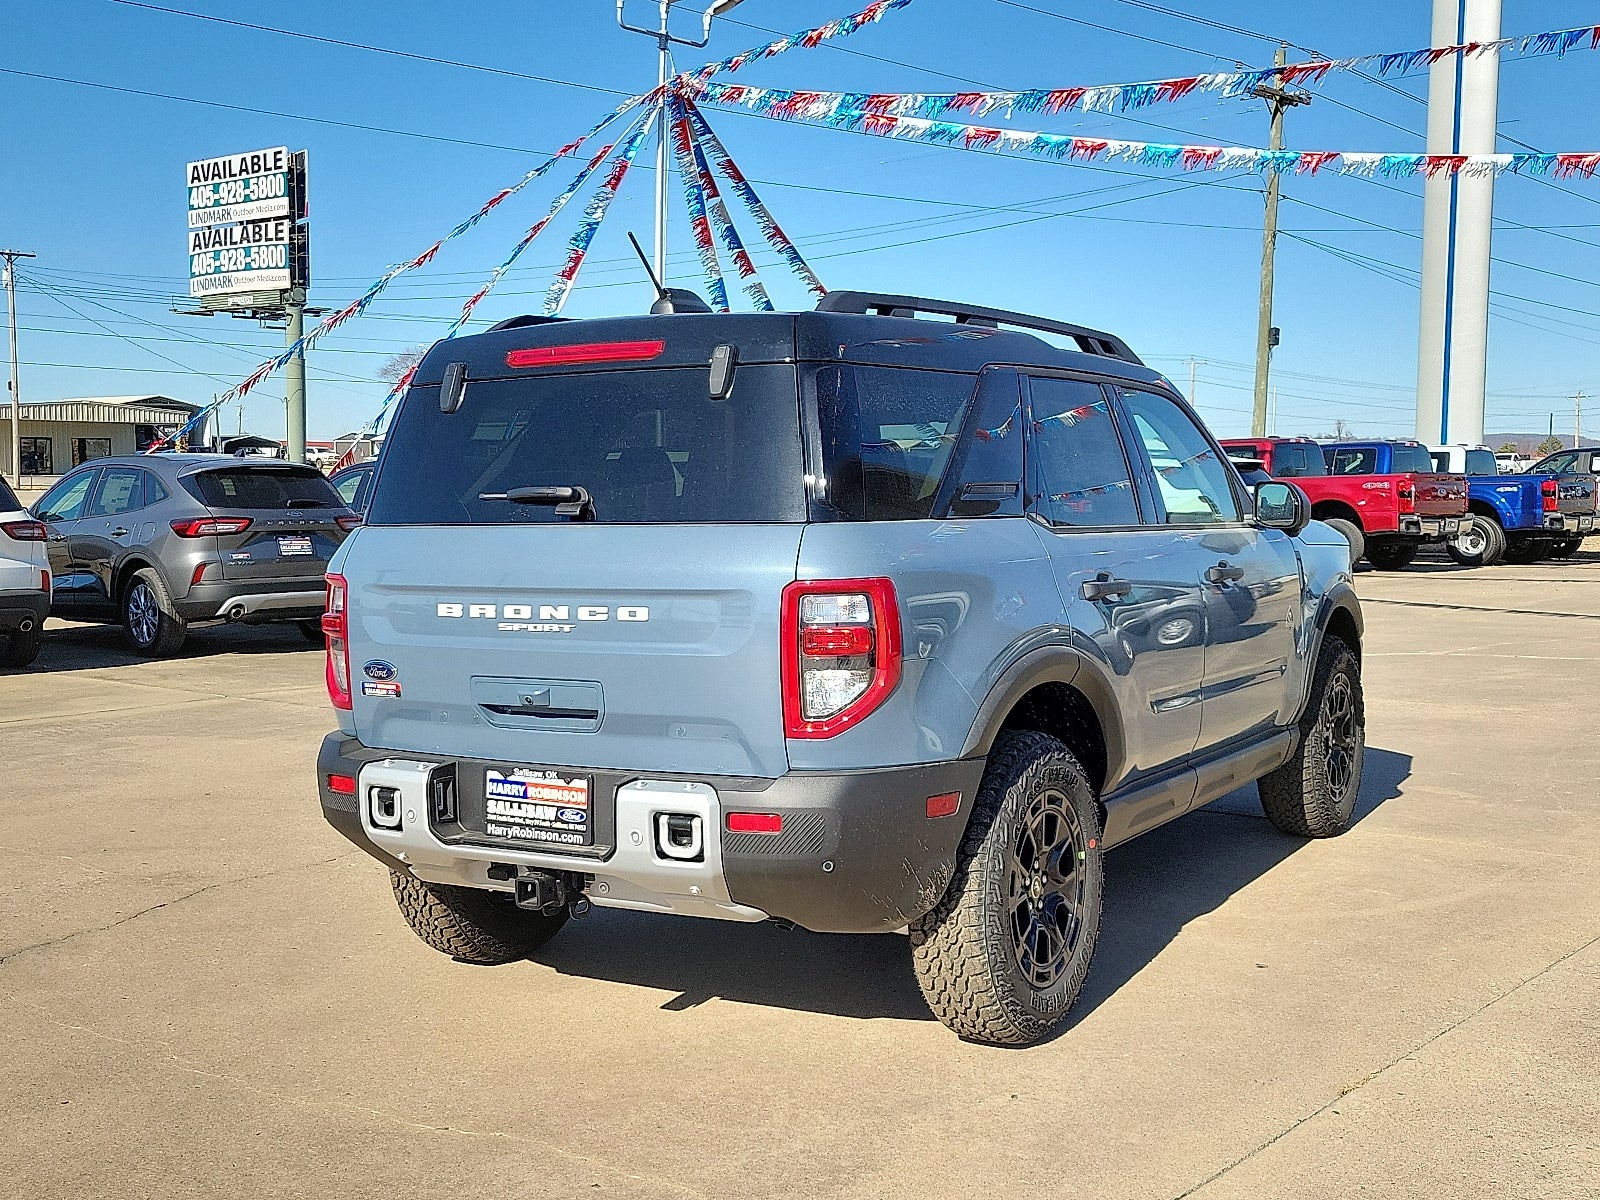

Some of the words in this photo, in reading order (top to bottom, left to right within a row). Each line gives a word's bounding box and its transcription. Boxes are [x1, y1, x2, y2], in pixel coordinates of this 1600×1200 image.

[190, 150, 283, 184] AVAILABLE
[189, 174, 284, 209] 405-928-5800
[190, 208, 232, 225] LINDMARK
[233, 207, 254, 217] Outdoor
[192, 221, 285, 252] AVAILABLE
[191, 245, 286, 276] 405-928-5800
[192, 275, 234, 293] LINDMARK
[234, 276, 255, 284] Outdoor
[437, 603, 650, 622] BRONCO
[497, 622, 577, 633] SPORT
[546, 771, 558, 780] OK
[489, 781, 527, 797] HARRY
[527, 786, 586, 804] ROBINSON
[487, 800, 558, 821] SALLISAW
[487, 823, 584, 845] HarryRobinson.com
